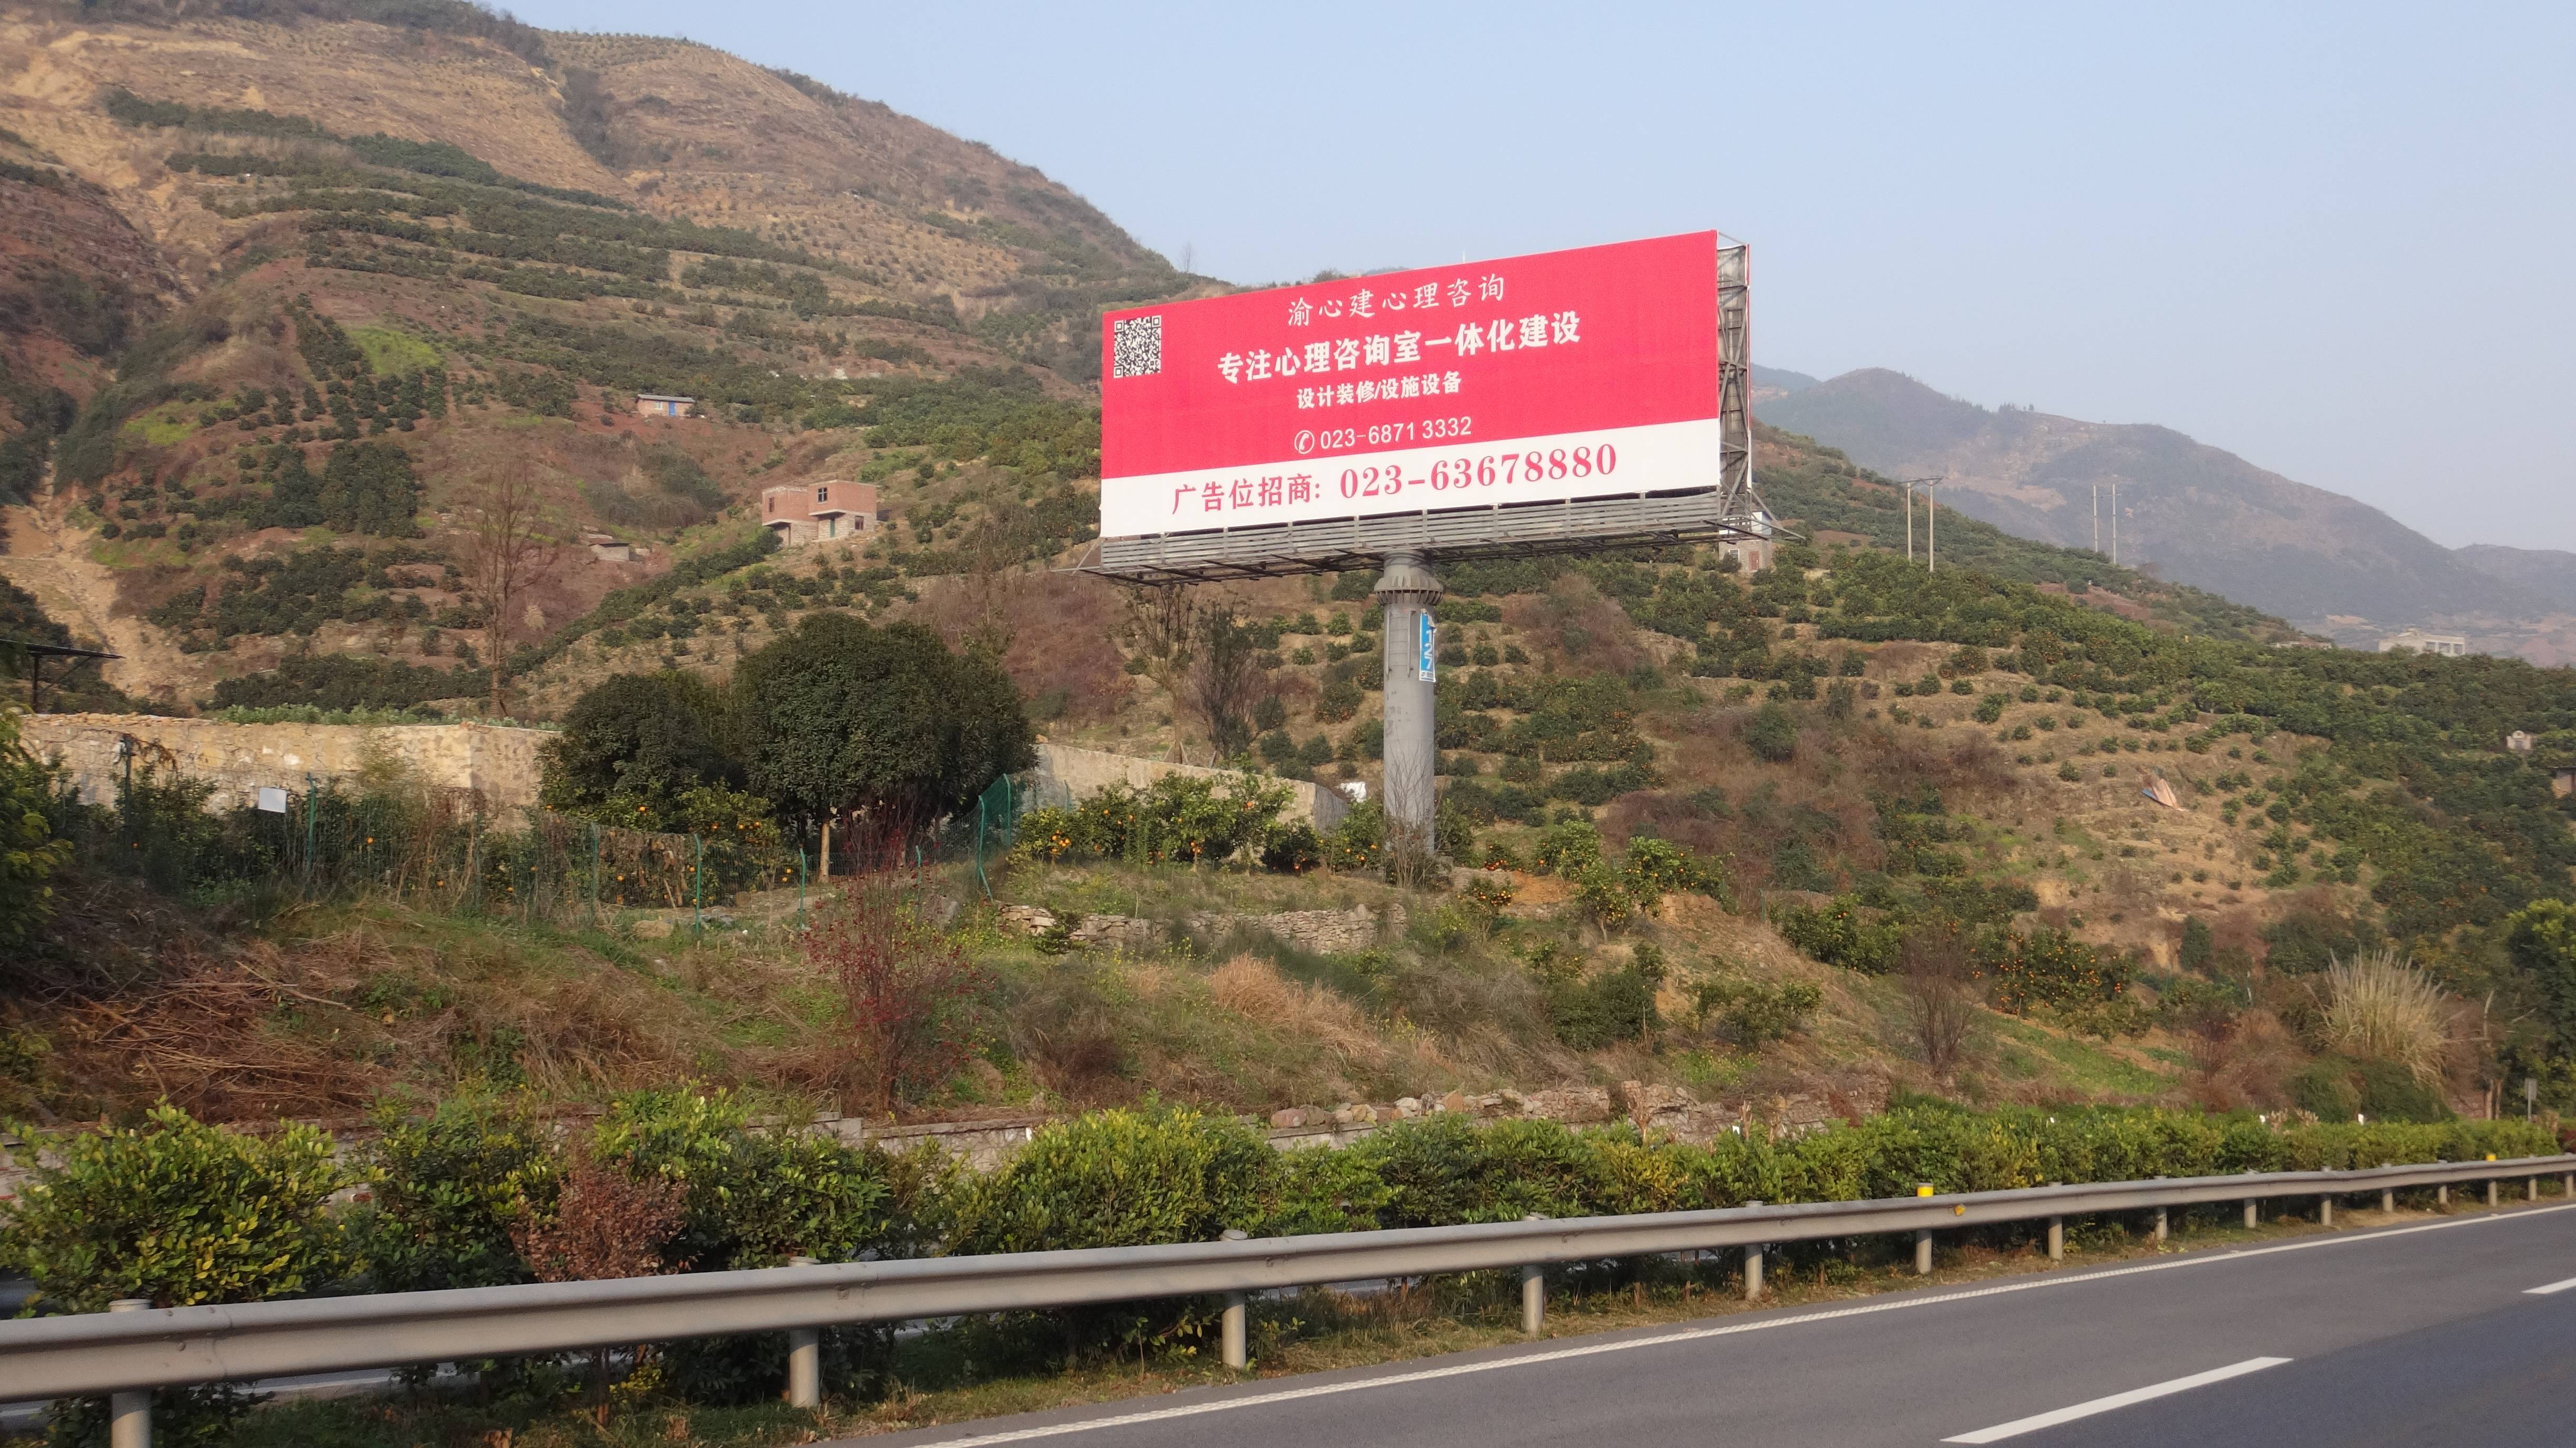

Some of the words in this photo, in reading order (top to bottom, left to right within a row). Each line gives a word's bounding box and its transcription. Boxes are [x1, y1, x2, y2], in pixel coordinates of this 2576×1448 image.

[1288, 273, 1504, 326] 渝心建心理咨询
[1217, 310, 1581, 384] 专注心理咨询室一体化建设
[1296, 370, 1462, 409] 设计装修/设施设备
[1172, 474, 1320, 514] 广告位招商：
[1341, 444, 1616, 498] 023-63678880
